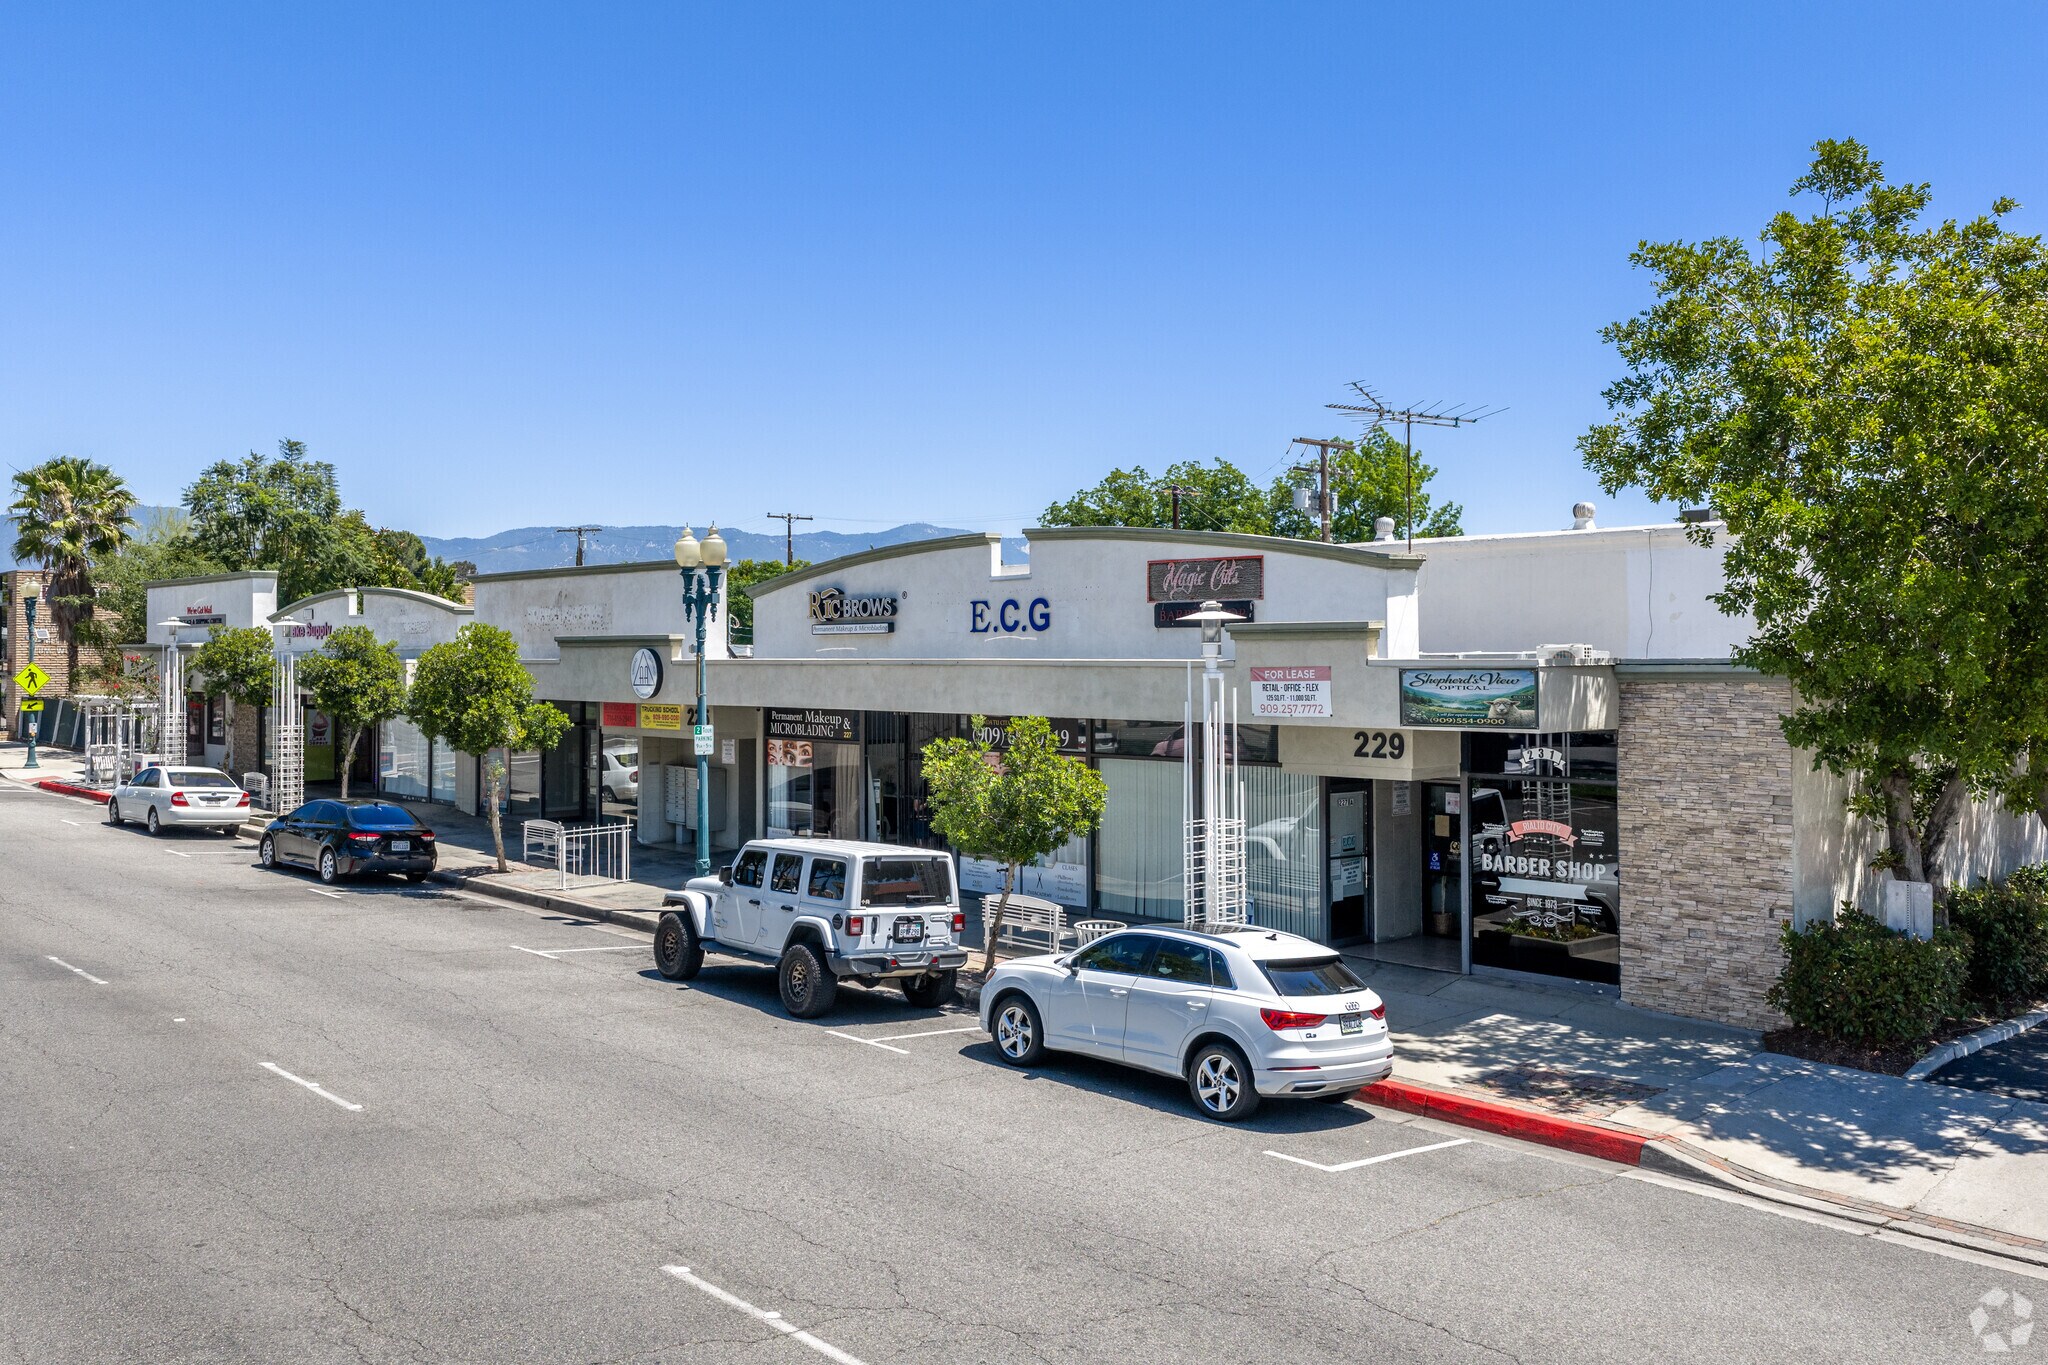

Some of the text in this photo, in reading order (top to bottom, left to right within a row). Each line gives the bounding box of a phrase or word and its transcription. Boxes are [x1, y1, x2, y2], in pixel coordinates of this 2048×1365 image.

[843, 598, 892, 617] BROWS
[970, 598, 1050, 632] E.C.G
[291, 622, 333, 639] ake Supply
[1264, 669, 1316, 679] FOR LEASE
[1409, 672, 1520, 687] Shepherd's View
[1262, 683, 1280, 692] RETAIL
[1283, 683, 1302, 692] OFFICE
[1305, 683, 1319, 692] FLEX
[1260, 703, 1324, 714] 909.257.7772
[772, 710, 851, 729] Permanent Makeup &
[1430, 717, 1506, 725] (909)554-0900
[770, 722, 834, 737] MICROBLADING
[1354, 731, 1405, 760] 229
[1522, 820, 1562, 833] RIALTO CITY
[1481, 853, 1606, 880] BARBER SHOP
[1527, 897, 1557, 909] SINCE 1973
